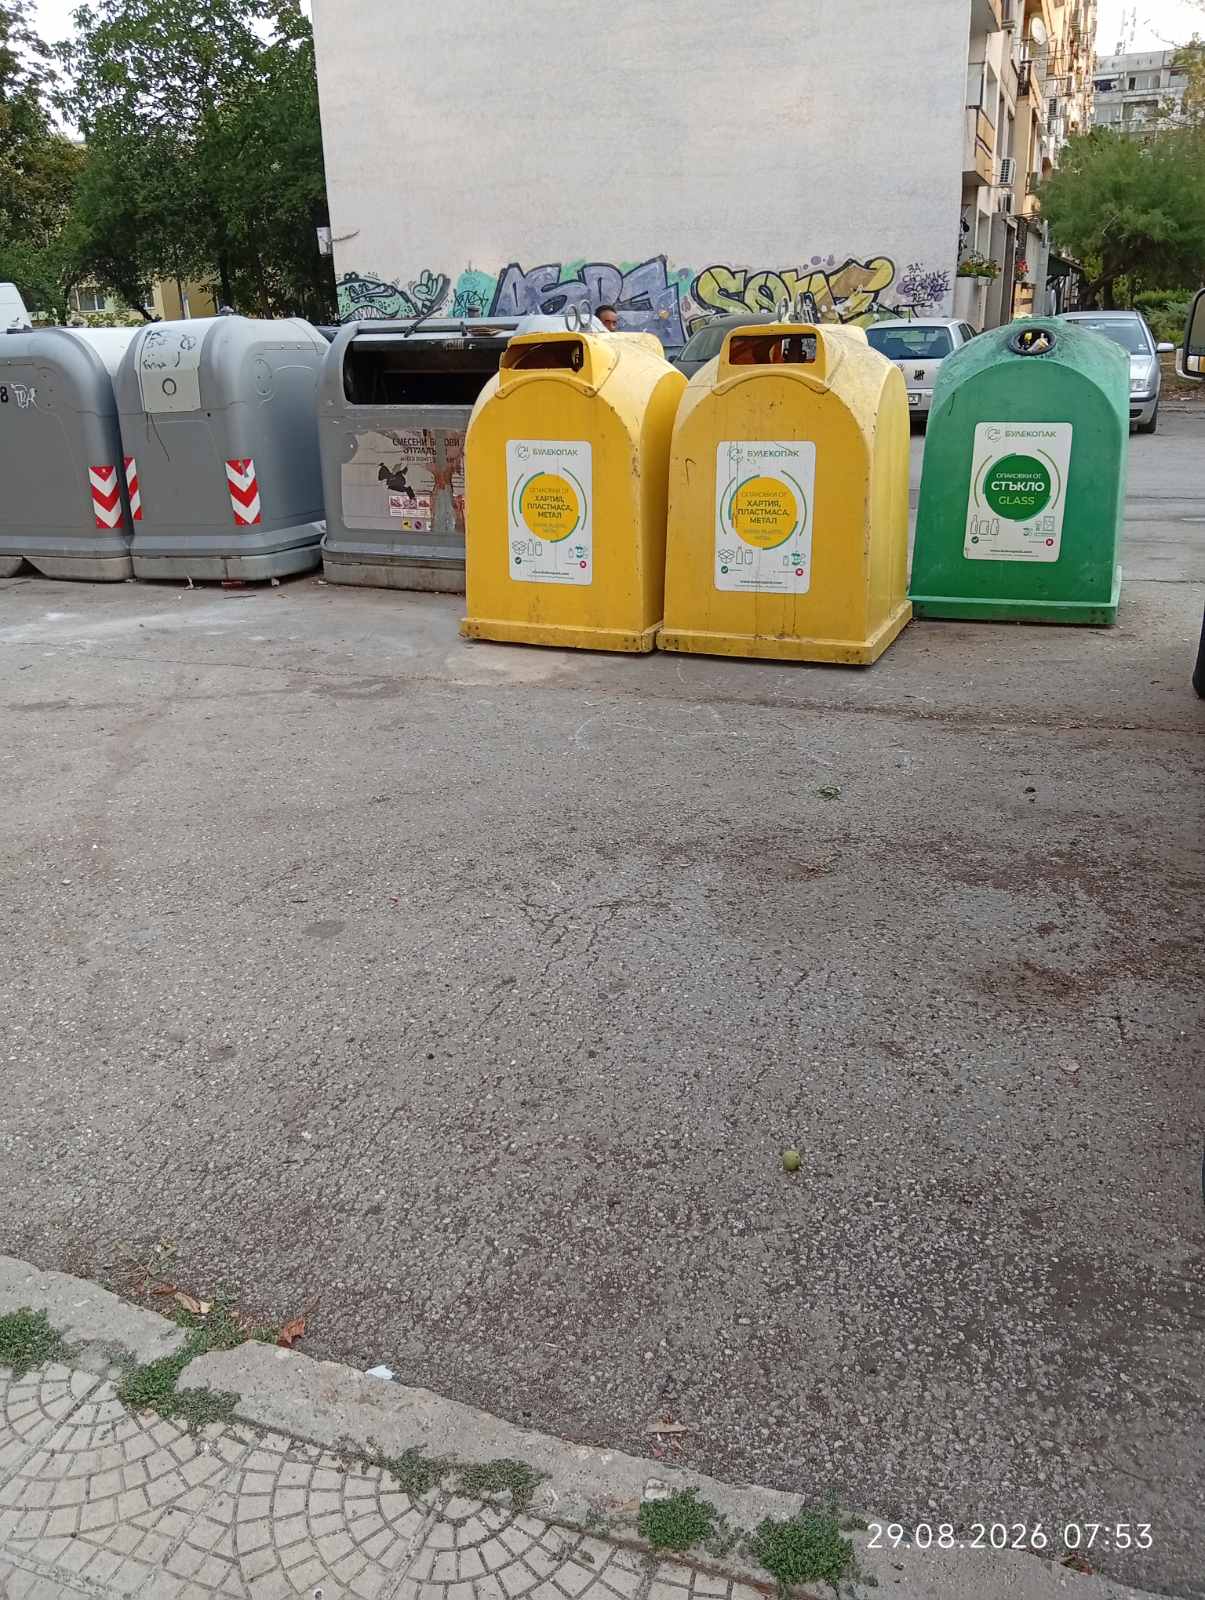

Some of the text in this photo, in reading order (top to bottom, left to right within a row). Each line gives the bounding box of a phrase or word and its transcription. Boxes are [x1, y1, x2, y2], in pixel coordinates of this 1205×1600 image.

[1005, 430, 1056, 438] БУЛЕКОПАК
[991, 481, 1045, 491] СТЪКЛО
[998, 496, 1035, 505] GLASS
